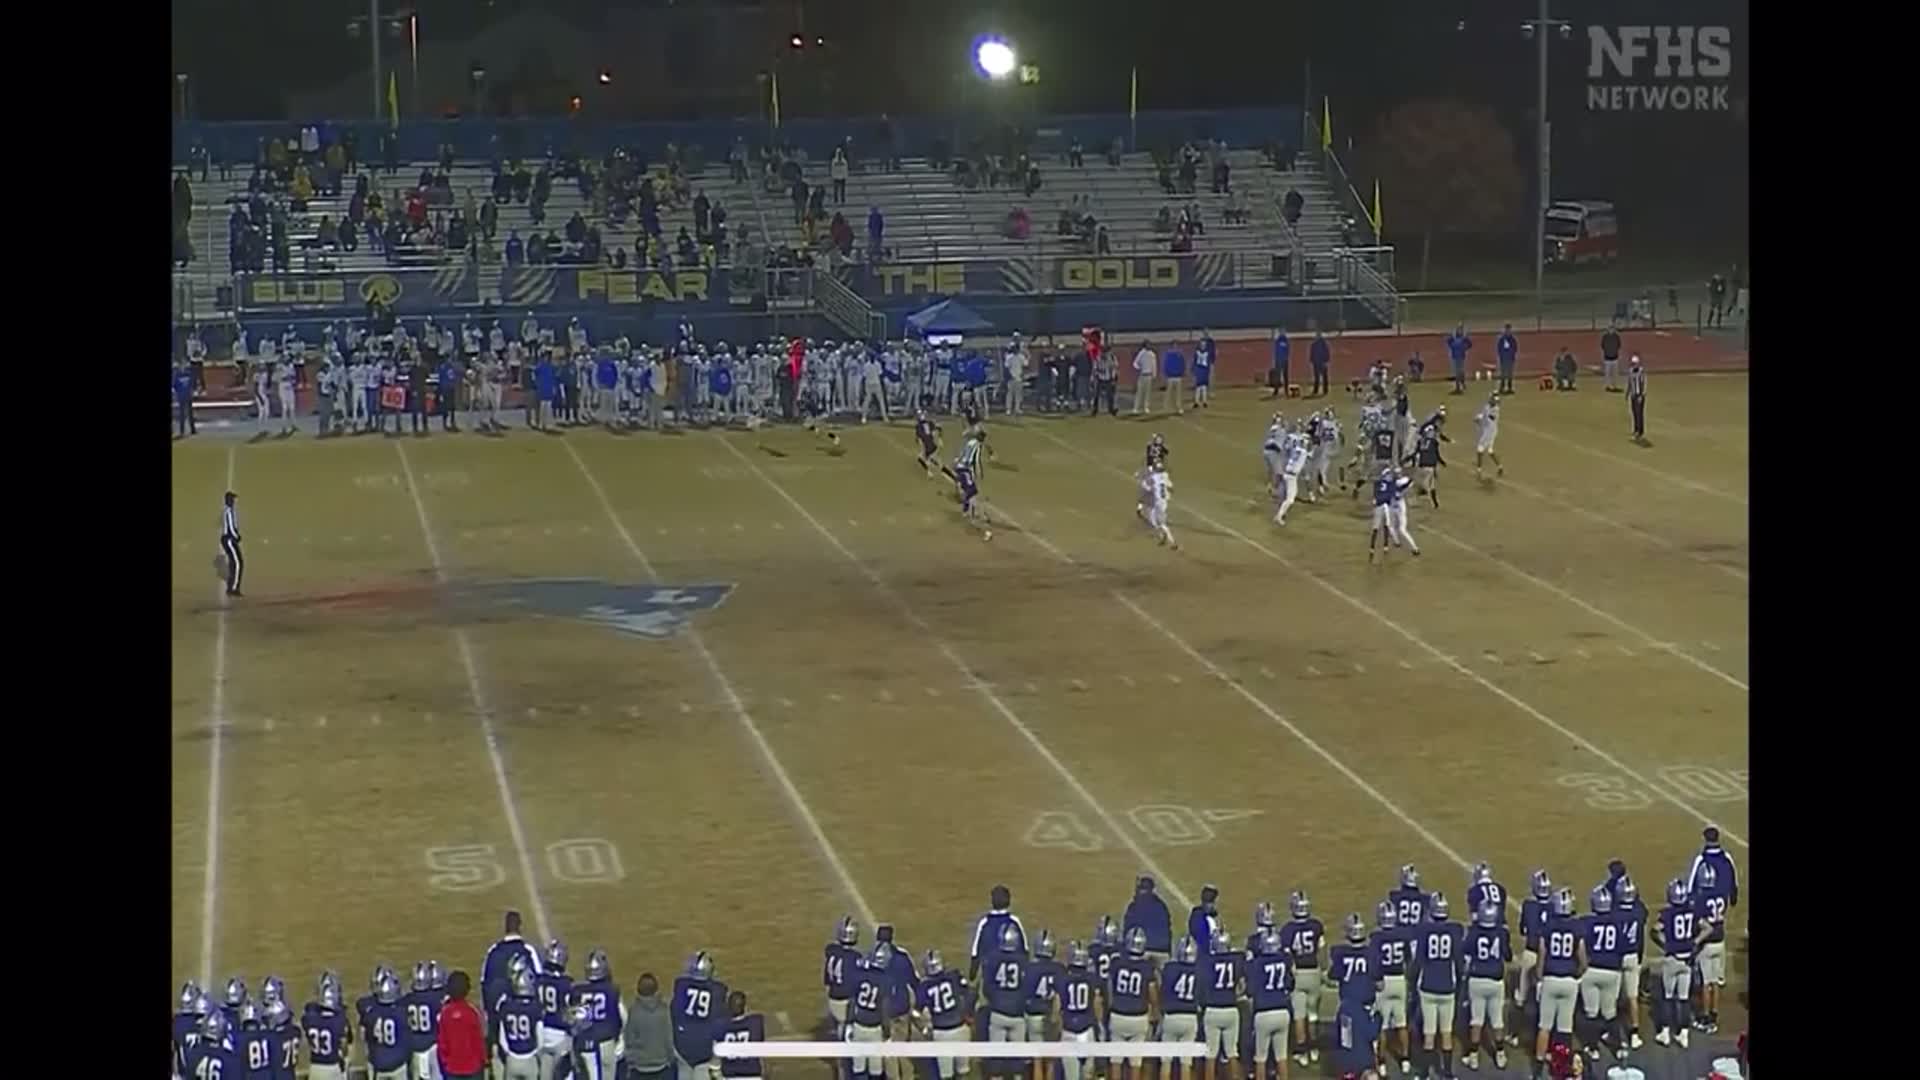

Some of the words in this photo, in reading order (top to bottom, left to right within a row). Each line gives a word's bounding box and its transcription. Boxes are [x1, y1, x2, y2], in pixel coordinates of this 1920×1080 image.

[578, 270, 708, 303] FEAR
[875, 264, 966, 295] THE
[1062, 258, 1180, 289] GOLD
[1022, 803, 1216, 851] 40
[425, 837, 626, 892] 50
[1479, 883, 1500, 902] 18
[1399, 900, 1422, 924] 29
[1706, 897, 1726, 923] 32
[1593, 925, 1617, 951] 78
[1674, 913, 1694, 939] 87
[1292, 931, 1315, 954] 45
[1381, 941, 1405, 966] 35
[1428, 933, 1452, 959] 88
[1477, 936, 1501, 960] 64
[1550, 931, 1574, 957] 68
[995, 962, 1019, 989] 43
[1116, 968, 1142, 996] 60
[1173, 974, 1195, 999] 41
[1214, 962, 1235, 989] 71
[1264, 962, 1287, 990] 77
[685, 988, 712, 1017] 79
[857, 982, 878, 1009] 21
[927, 981, 956, 1013] 72
[1067, 982, 1089, 1010] 10
[373, 1018, 397, 1046] 48
[407, 1004, 431, 1033] 38
[506, 1014, 531, 1041] 39
[247, 1039, 269, 1070] 81
[308, 1028, 333, 1056] 33
[195, 1056, 222, 1080] 46
